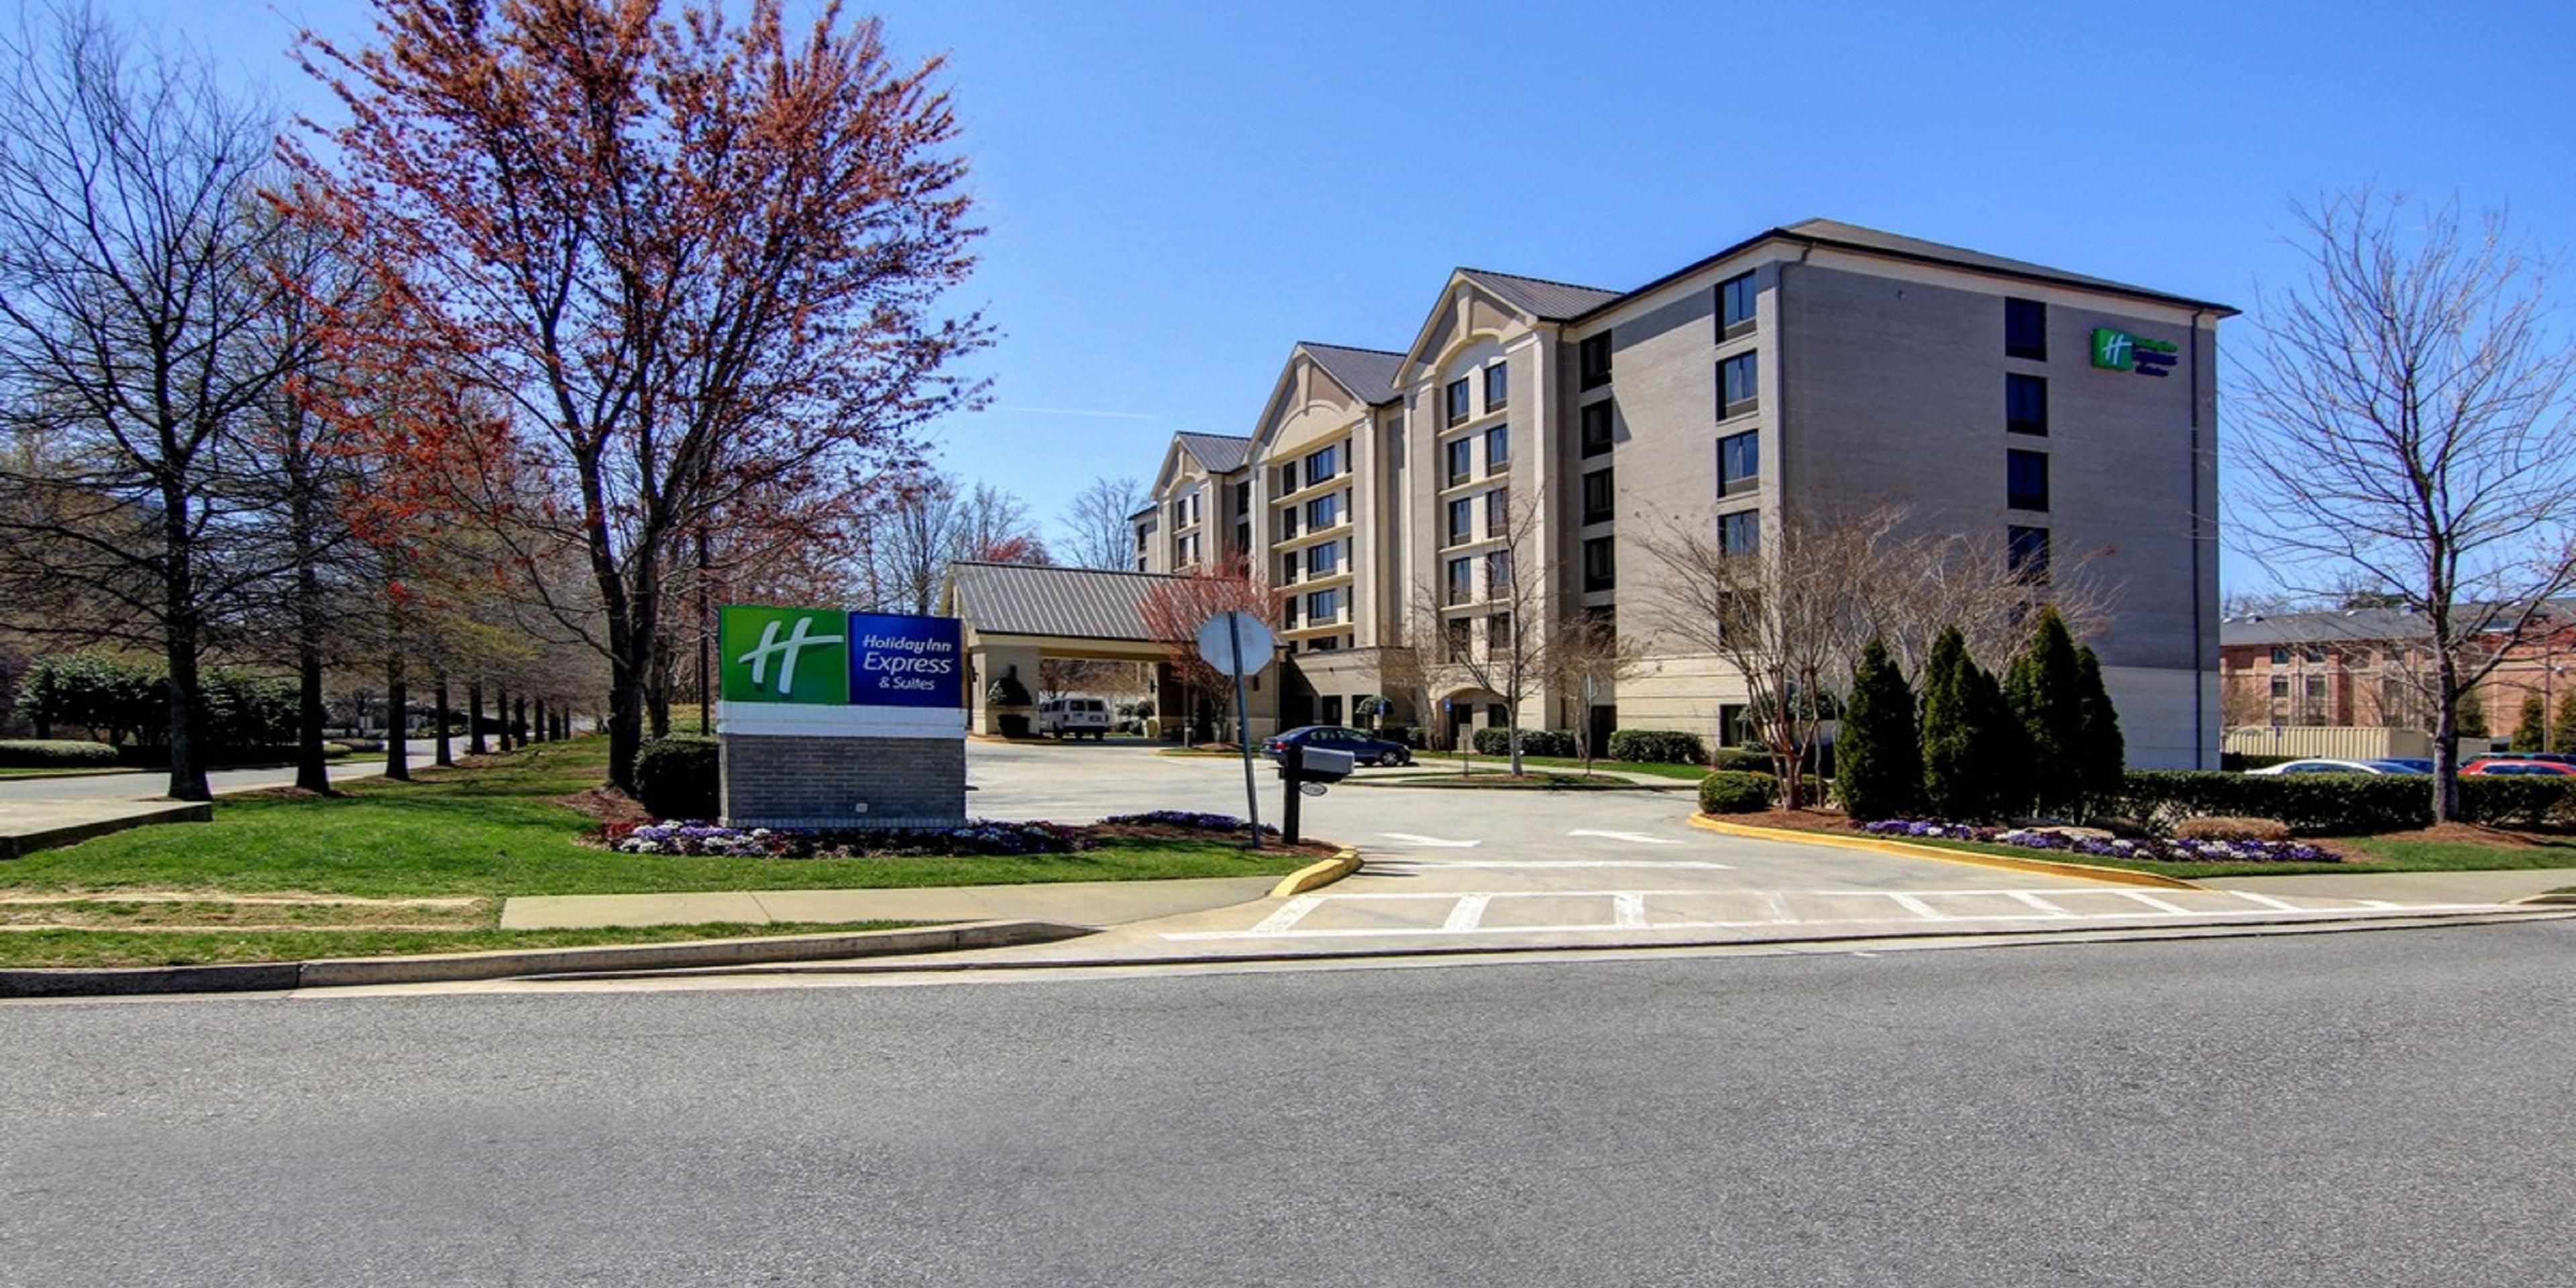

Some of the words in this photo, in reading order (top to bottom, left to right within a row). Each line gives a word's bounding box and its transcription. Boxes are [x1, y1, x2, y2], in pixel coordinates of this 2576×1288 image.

[739, 616, 844, 694] H
[862, 635, 925, 654] Holiday
[926, 638, 952, 652] Inn
[863, 651, 953, 676] Express
[879, 676, 890, 688] &
[892, 676, 935, 690] Suites
